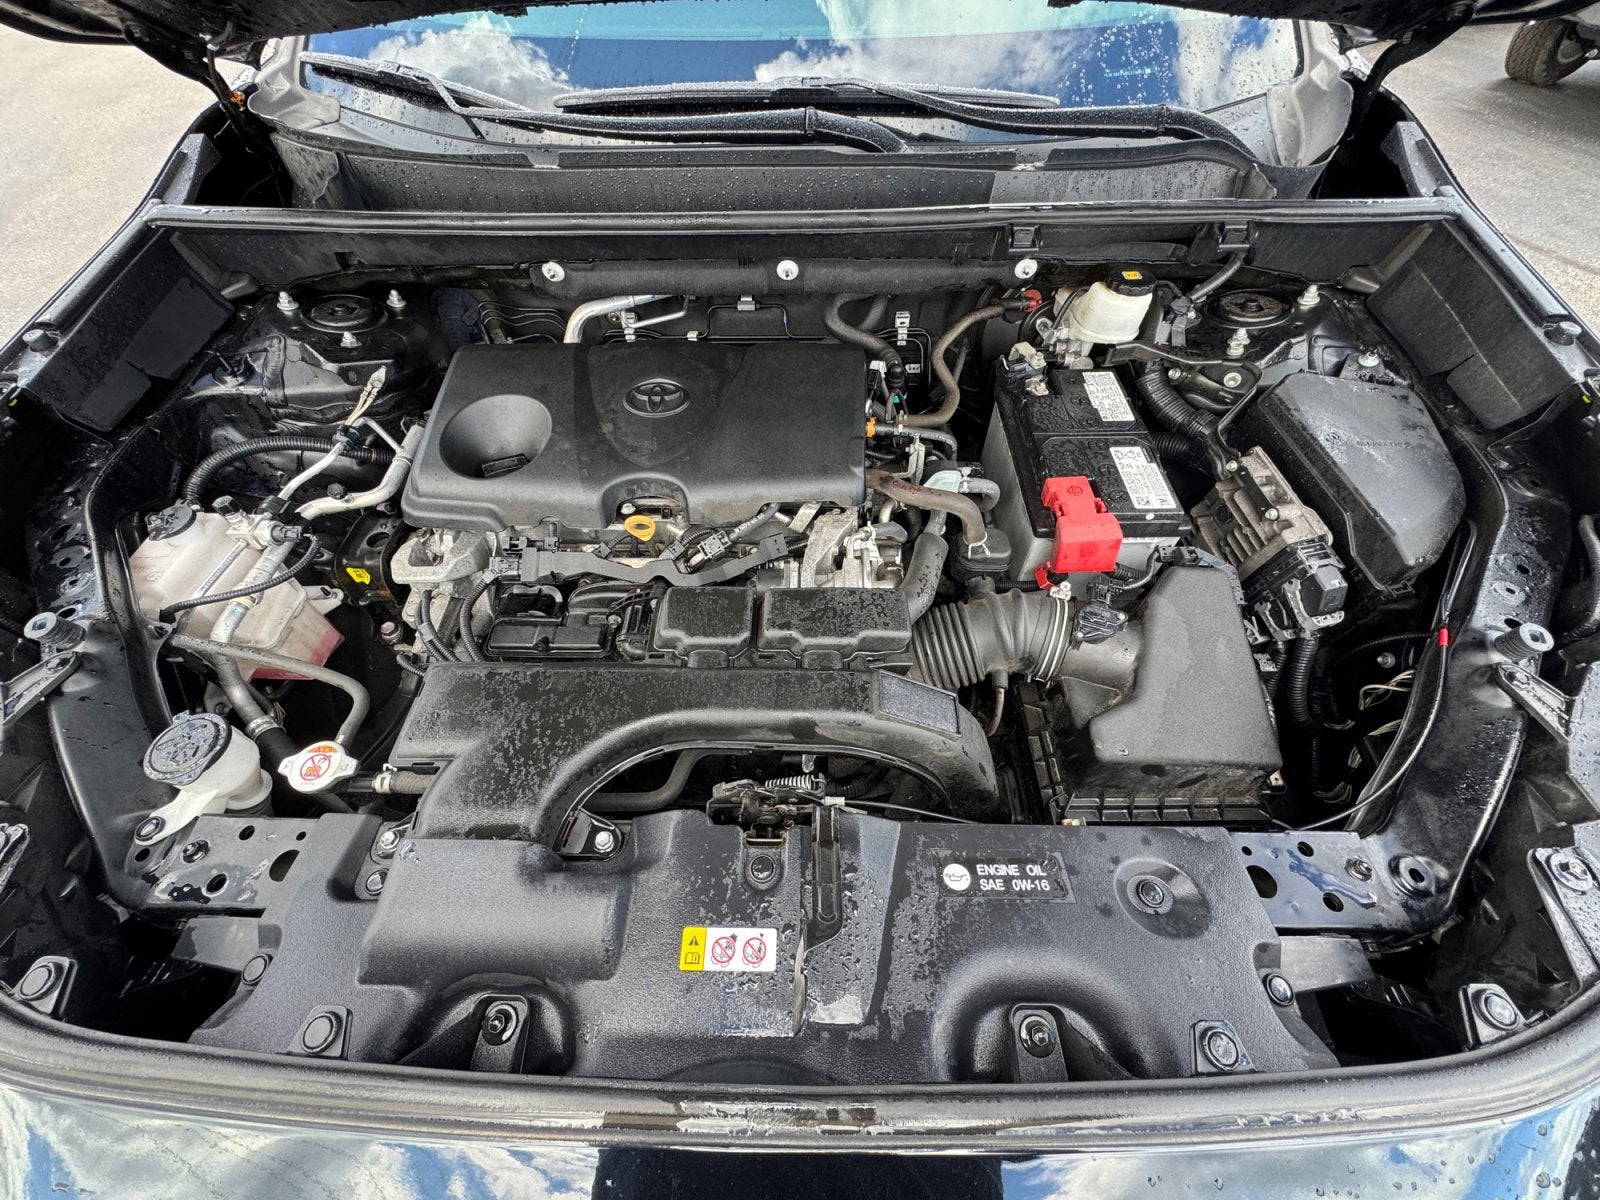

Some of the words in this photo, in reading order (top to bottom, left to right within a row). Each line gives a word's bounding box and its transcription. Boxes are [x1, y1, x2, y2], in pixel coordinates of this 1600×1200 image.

[976, 864, 1020, 876] ENGINE
[1026, 864, 1047, 876] OIL
[979, 879, 1005, 891] SAE
[1012, 879, 1050, 891] 0W-16
